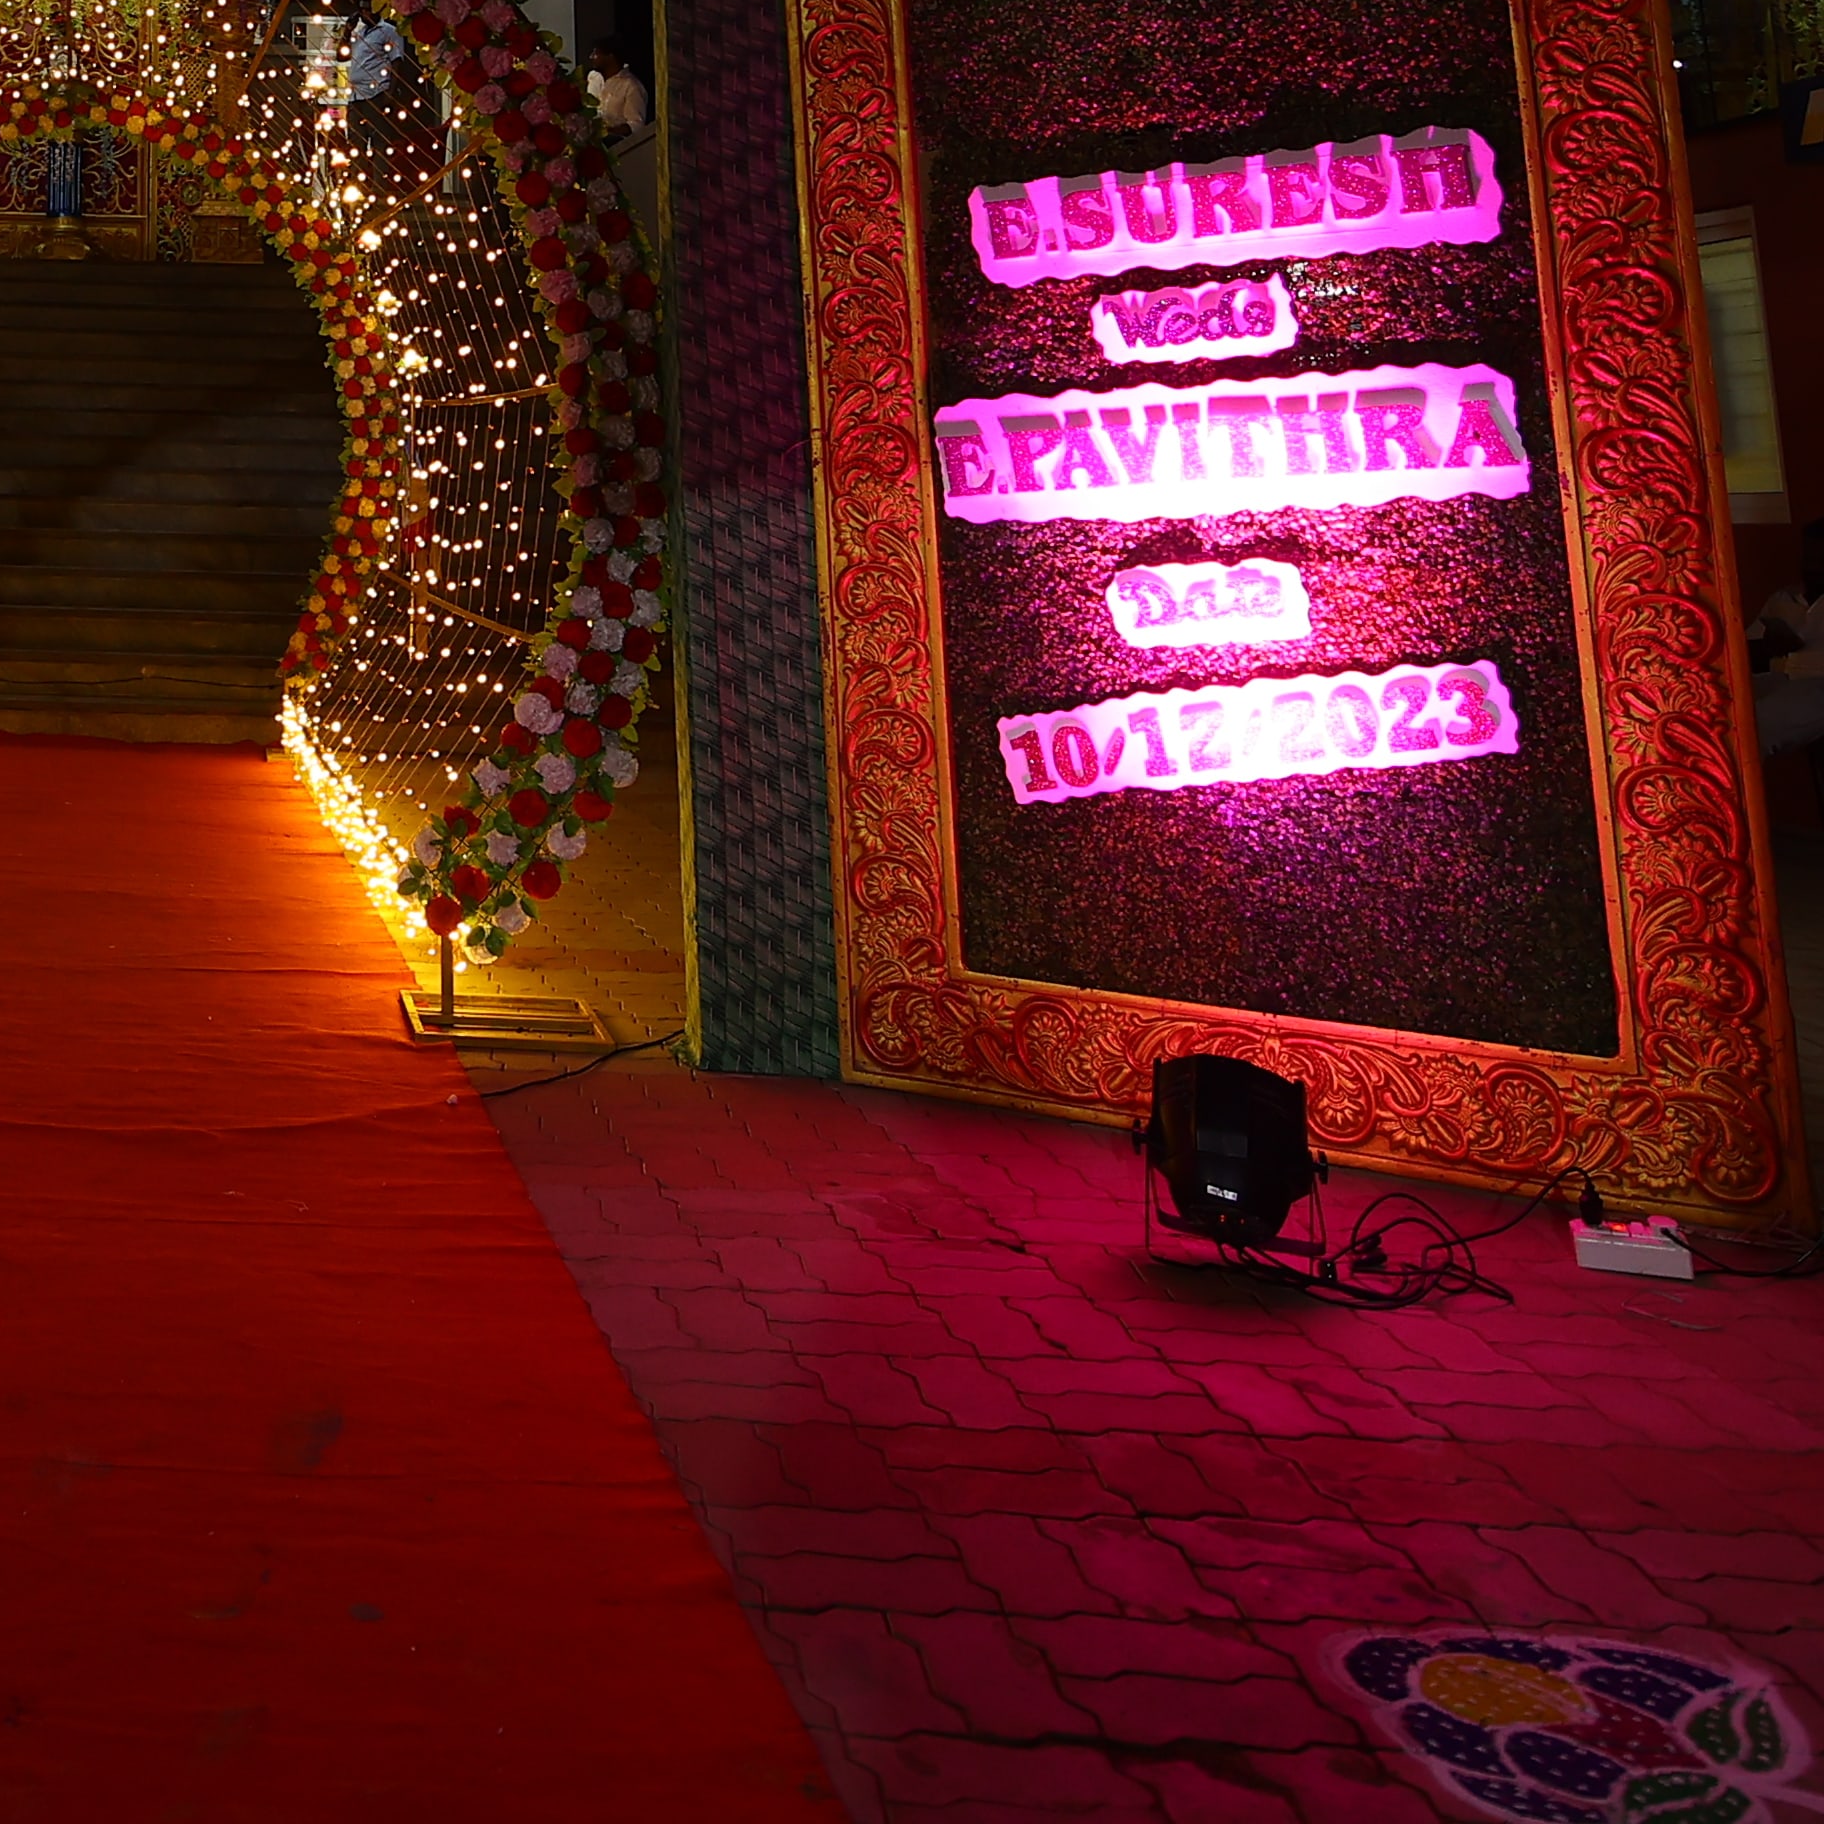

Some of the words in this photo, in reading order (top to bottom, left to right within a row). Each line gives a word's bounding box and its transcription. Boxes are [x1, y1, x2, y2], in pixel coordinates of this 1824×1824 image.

[979, 134, 1480, 261] E.SURESH
[1117, 569, 1284, 629] Date
[1005, 667, 1502, 793] 10/12/2023
